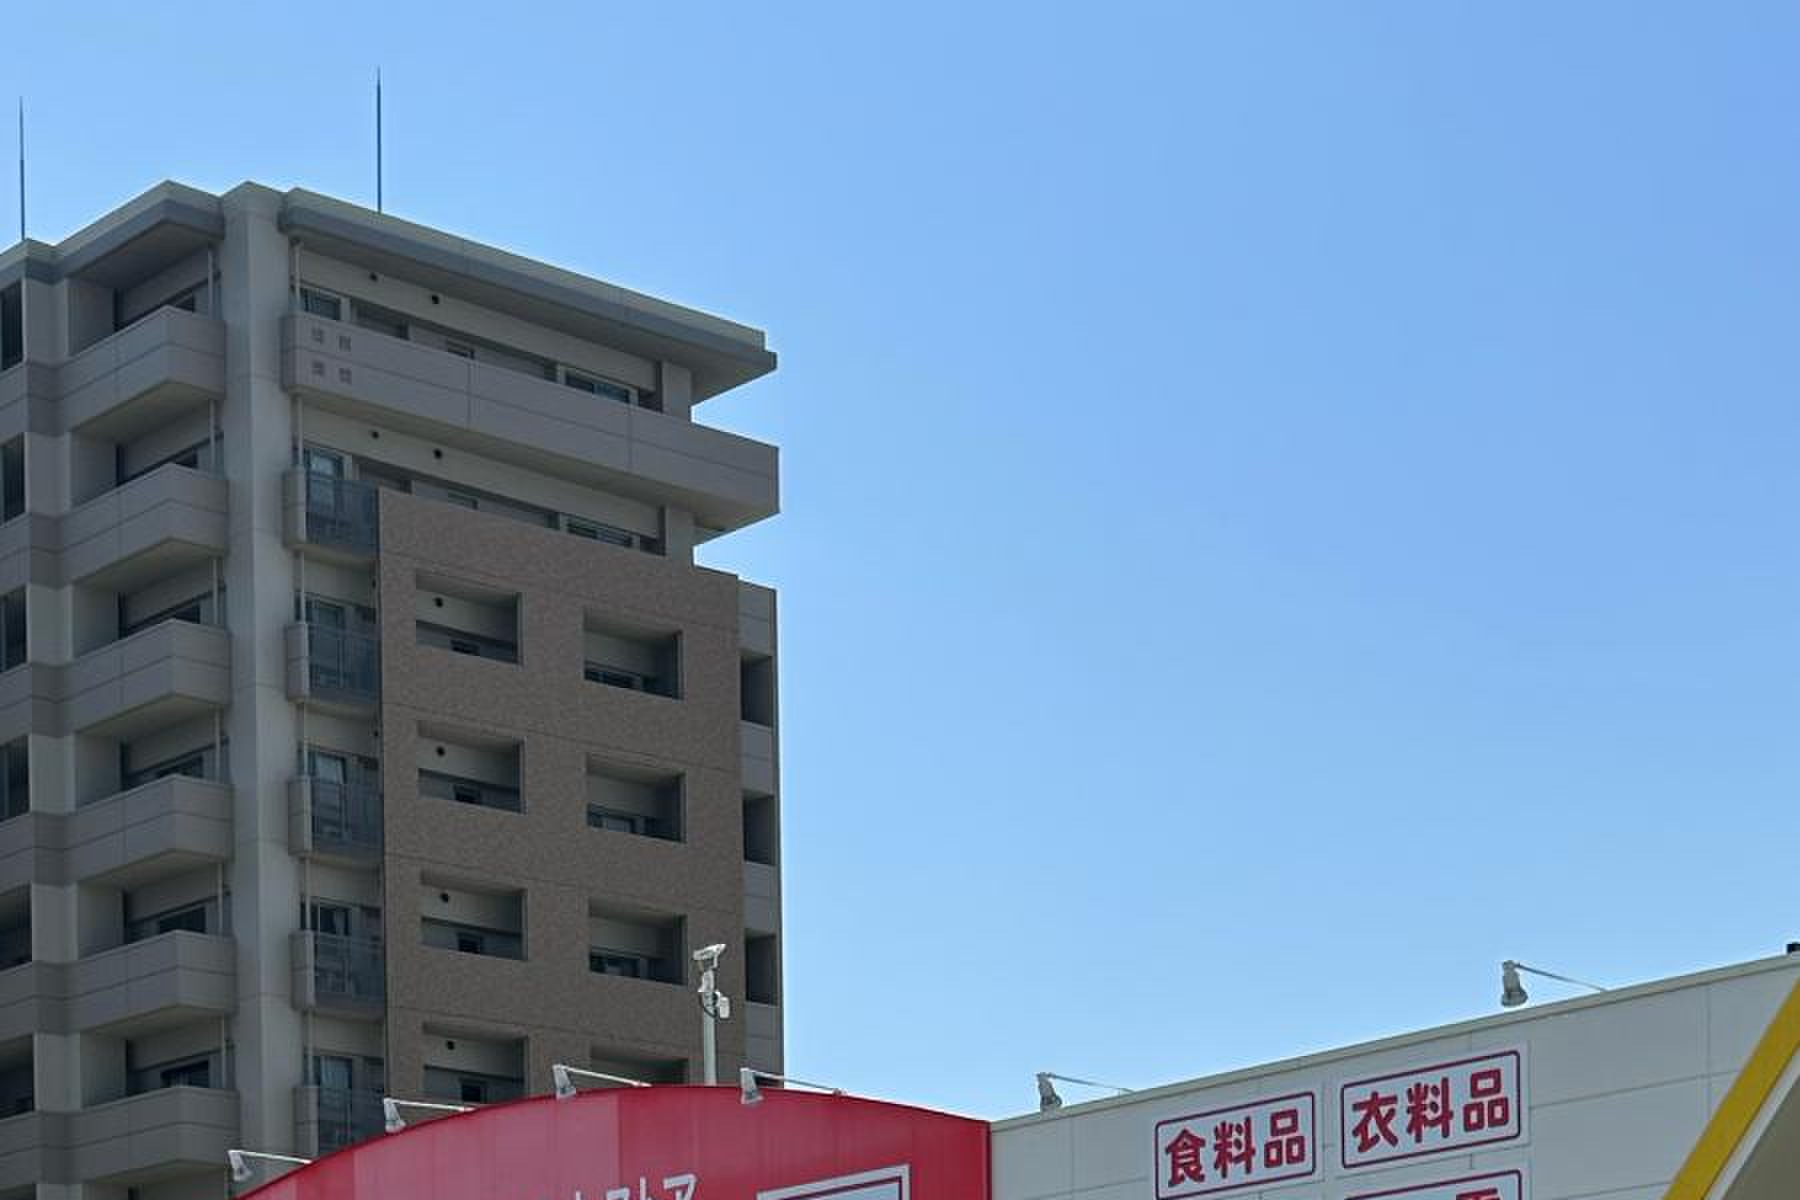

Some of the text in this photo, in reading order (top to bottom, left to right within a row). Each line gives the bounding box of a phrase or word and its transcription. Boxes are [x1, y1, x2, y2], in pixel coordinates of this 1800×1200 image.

[1165, 1109, 1306, 1188] 食料品
[1352, 1069, 1510, 1153] 衣料品
